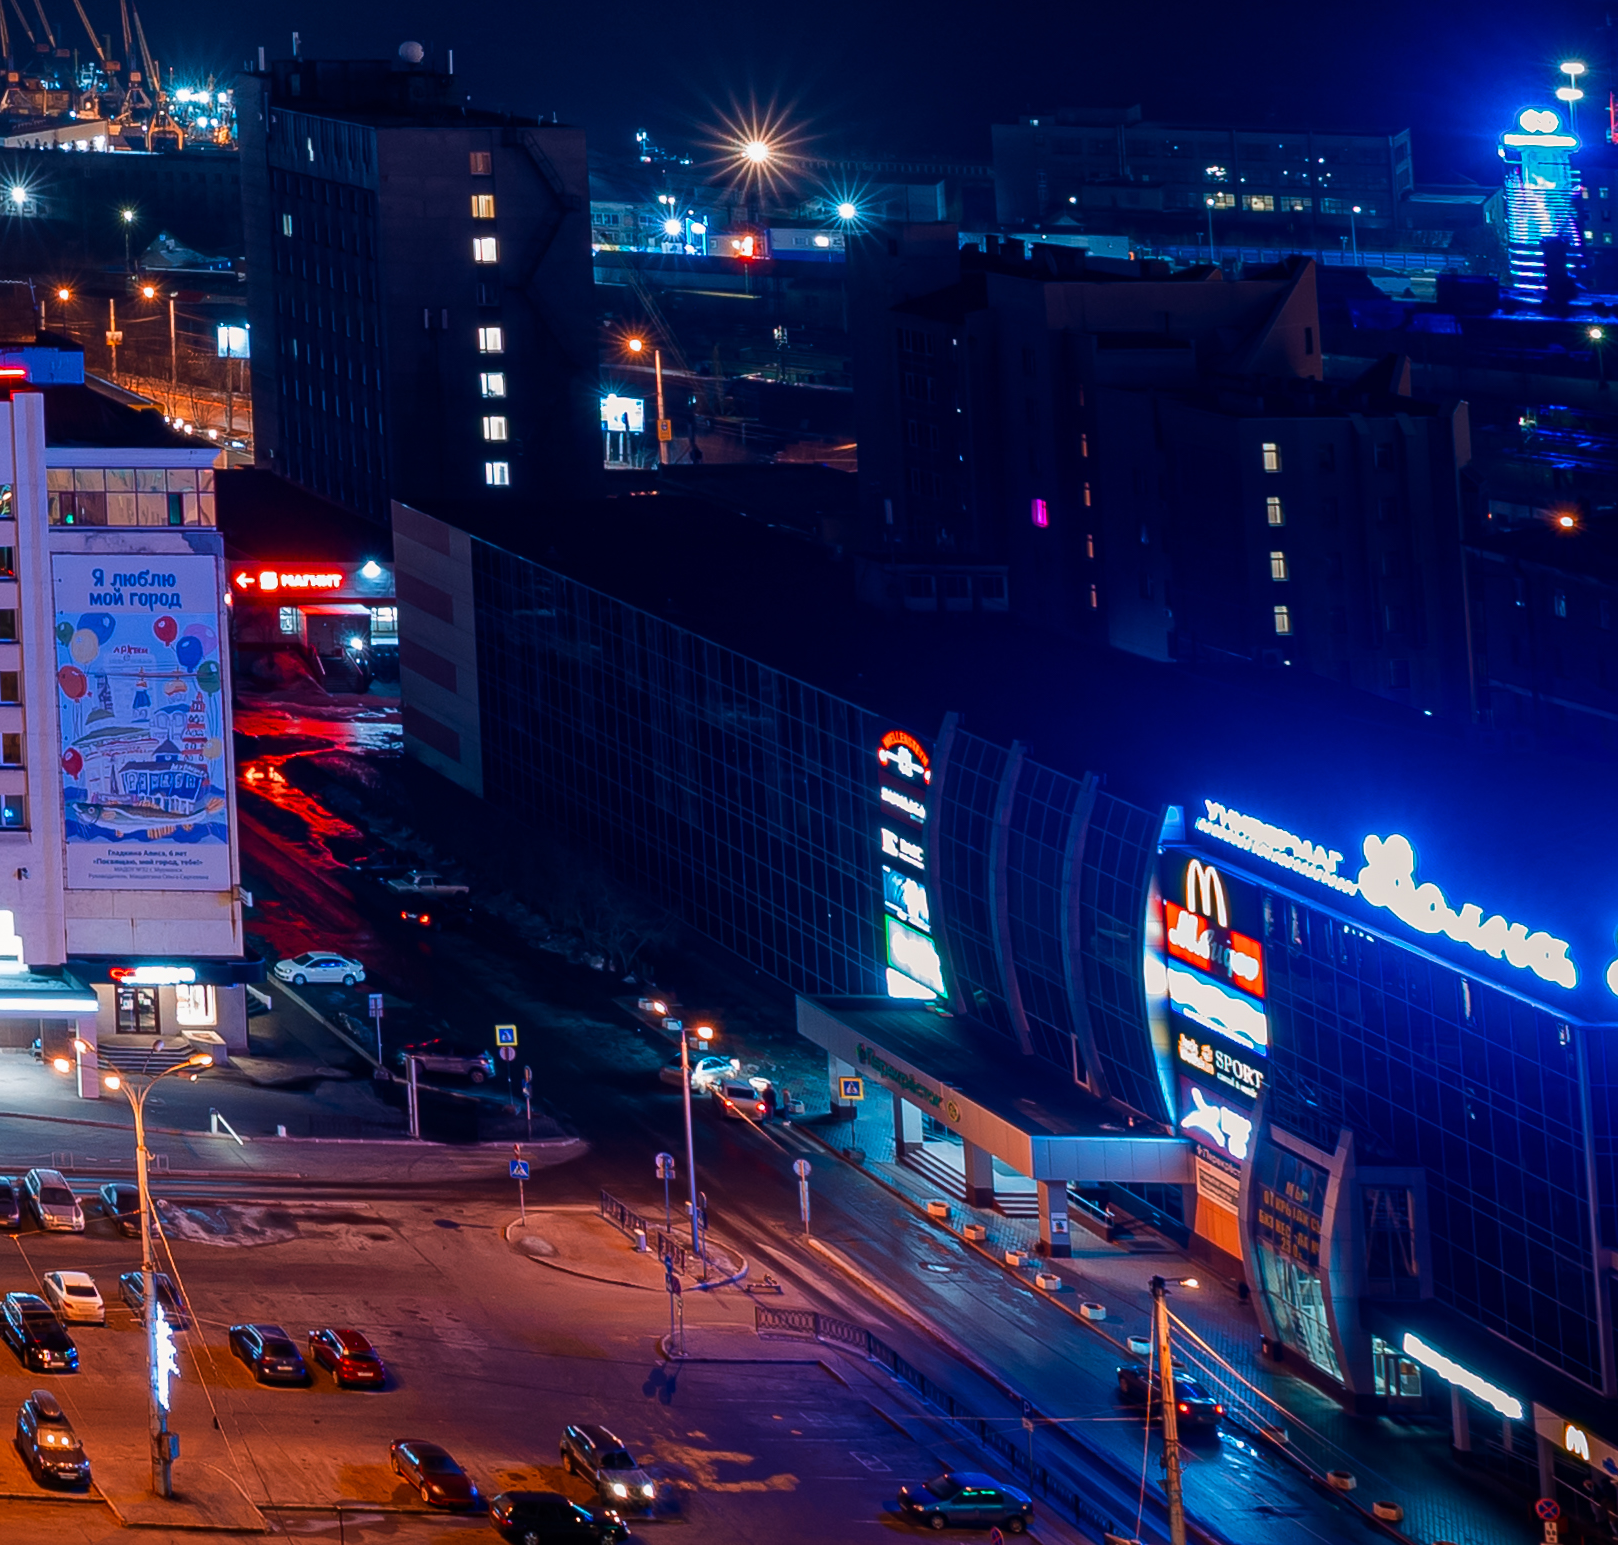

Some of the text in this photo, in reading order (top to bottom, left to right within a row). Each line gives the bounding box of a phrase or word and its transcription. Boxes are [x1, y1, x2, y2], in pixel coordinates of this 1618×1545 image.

[91, 568, 176, 587] Я люблю
[280, 573, 343, 588] МАГНИТ
[89, 587, 182, 612] мой город
[1215, 1050, 1264, 1089] SPORT
